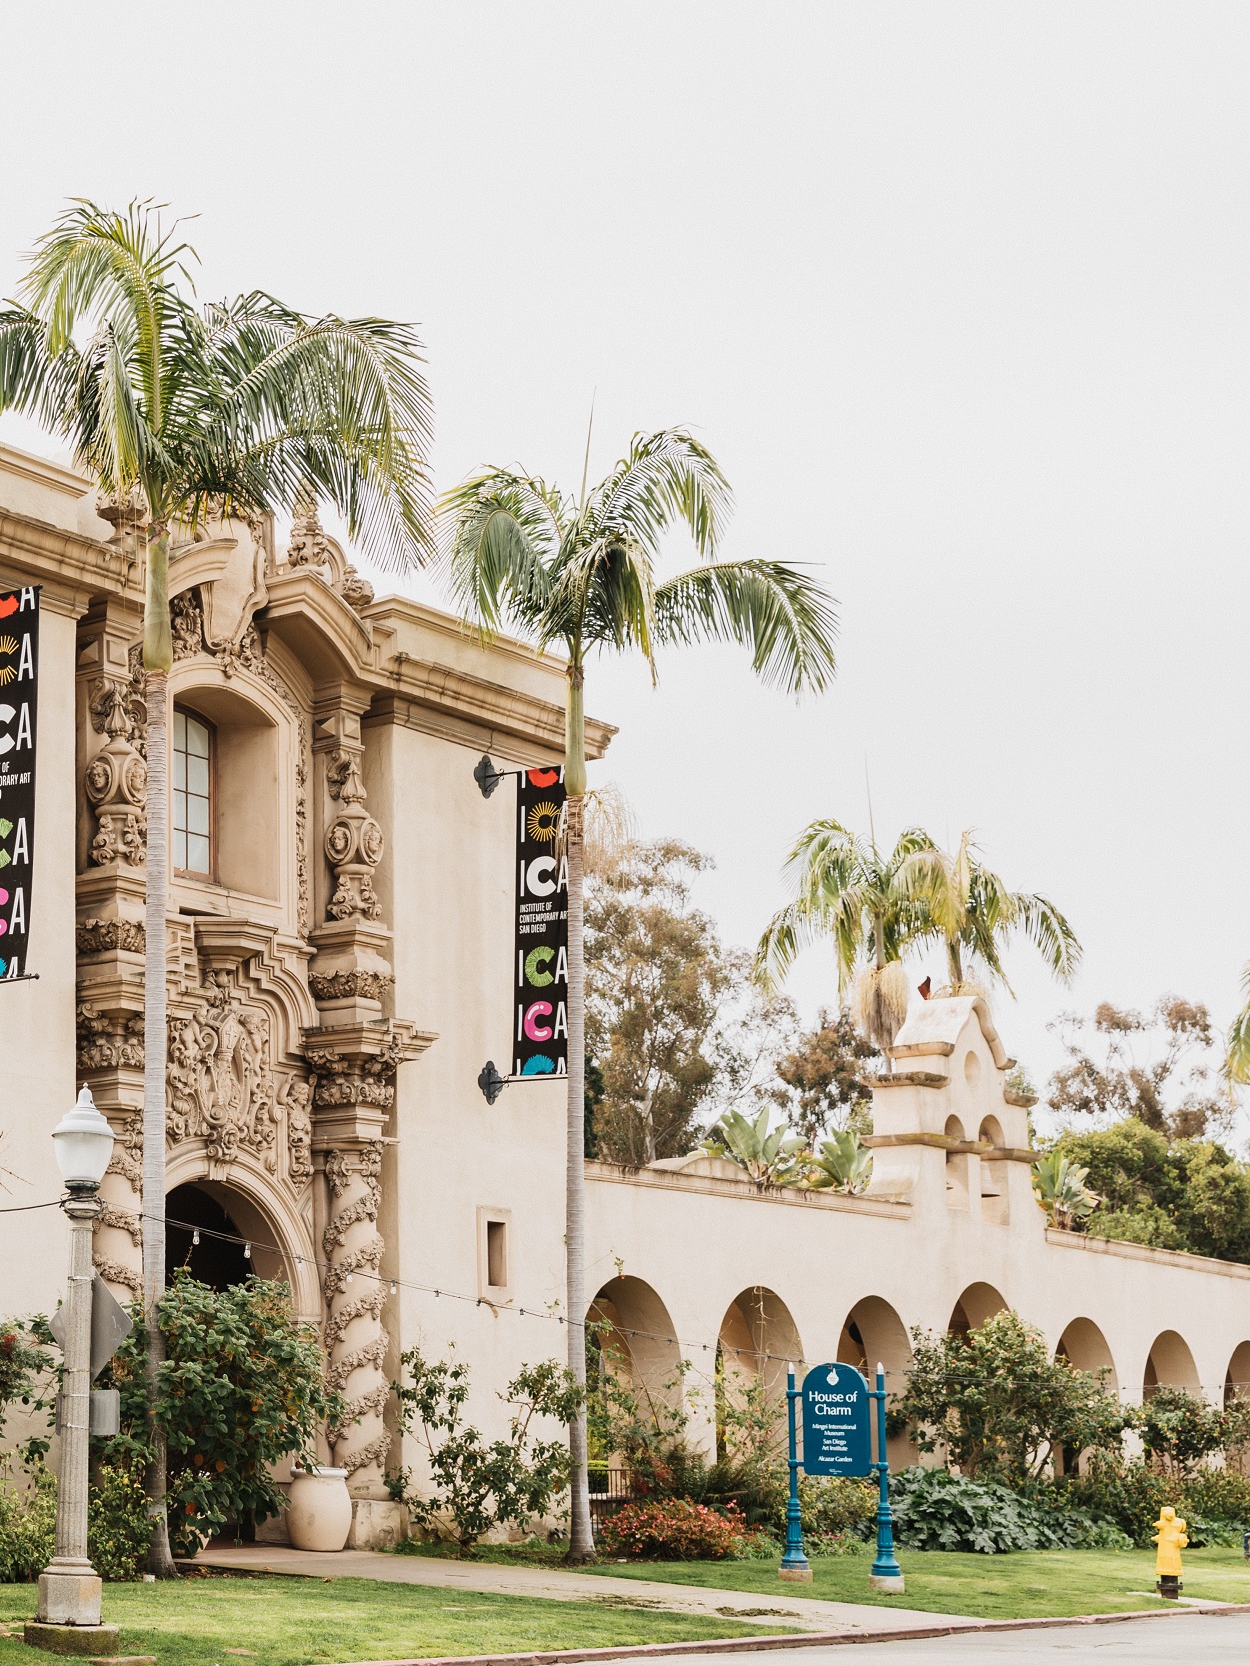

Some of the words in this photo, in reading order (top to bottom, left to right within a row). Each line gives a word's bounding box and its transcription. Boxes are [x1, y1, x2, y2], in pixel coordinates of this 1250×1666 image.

[1, 761, 10, 773] OF
[19, 772, 31, 785] ART
[520, 855, 569, 897] ICA
[519, 902, 545, 914] INSTITUTE
[545, 901, 553, 911] OF
[519, 911, 559, 924] CONTEMPORARY
[519, 924, 530, 934] SAN
[530, 923, 547, 934] DIEGO
[518, 945, 569, 988] ICA
[517, 1000, 569, 1042] ICA
[809, 1391, 844, 1402] House
[845, 1391, 858, 1402] of
[814, 1403, 852, 1415] Charm
[832, 1438, 847, 1446] Diego
